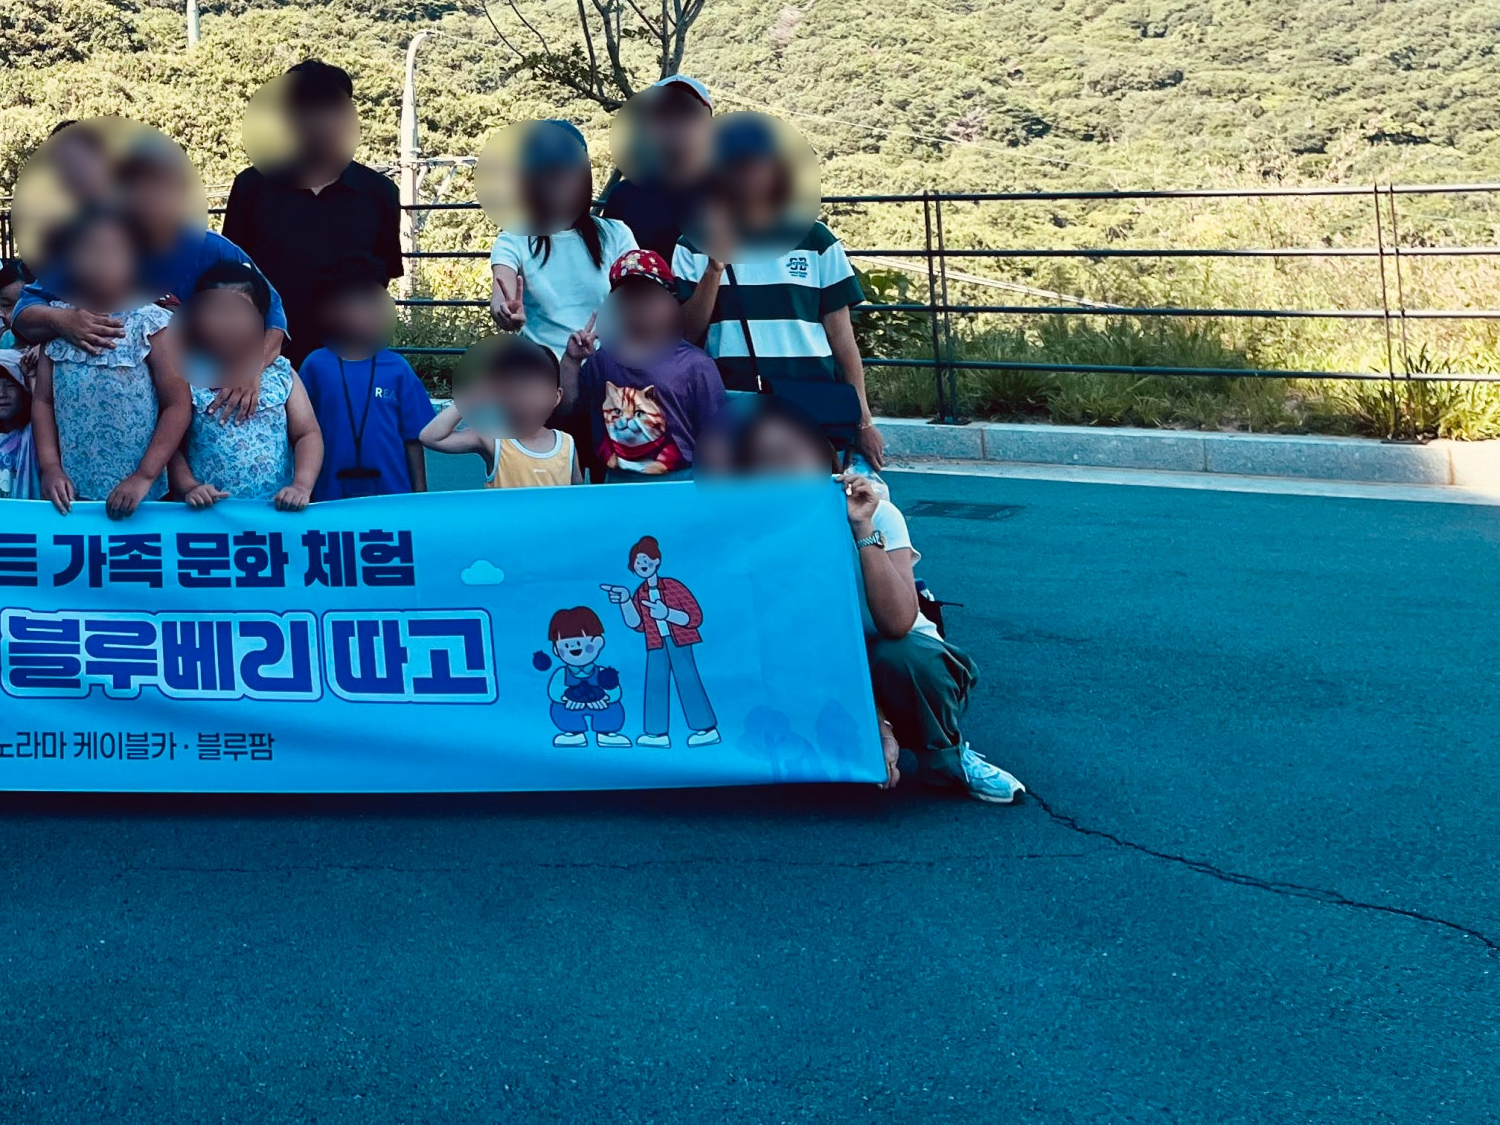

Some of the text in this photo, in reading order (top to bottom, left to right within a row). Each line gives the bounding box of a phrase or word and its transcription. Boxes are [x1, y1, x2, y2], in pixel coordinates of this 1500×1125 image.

[52, 532, 163, 588] 가족
[176, 530, 288, 588] 문화
[302, 529, 416, 587] 체험
[7, 615, 315, 693] 블루베리
[330, 618, 490, 695] 따고
[72, 731, 178, 761] 케이블카
[197, 731, 275, 762] 블루팜
